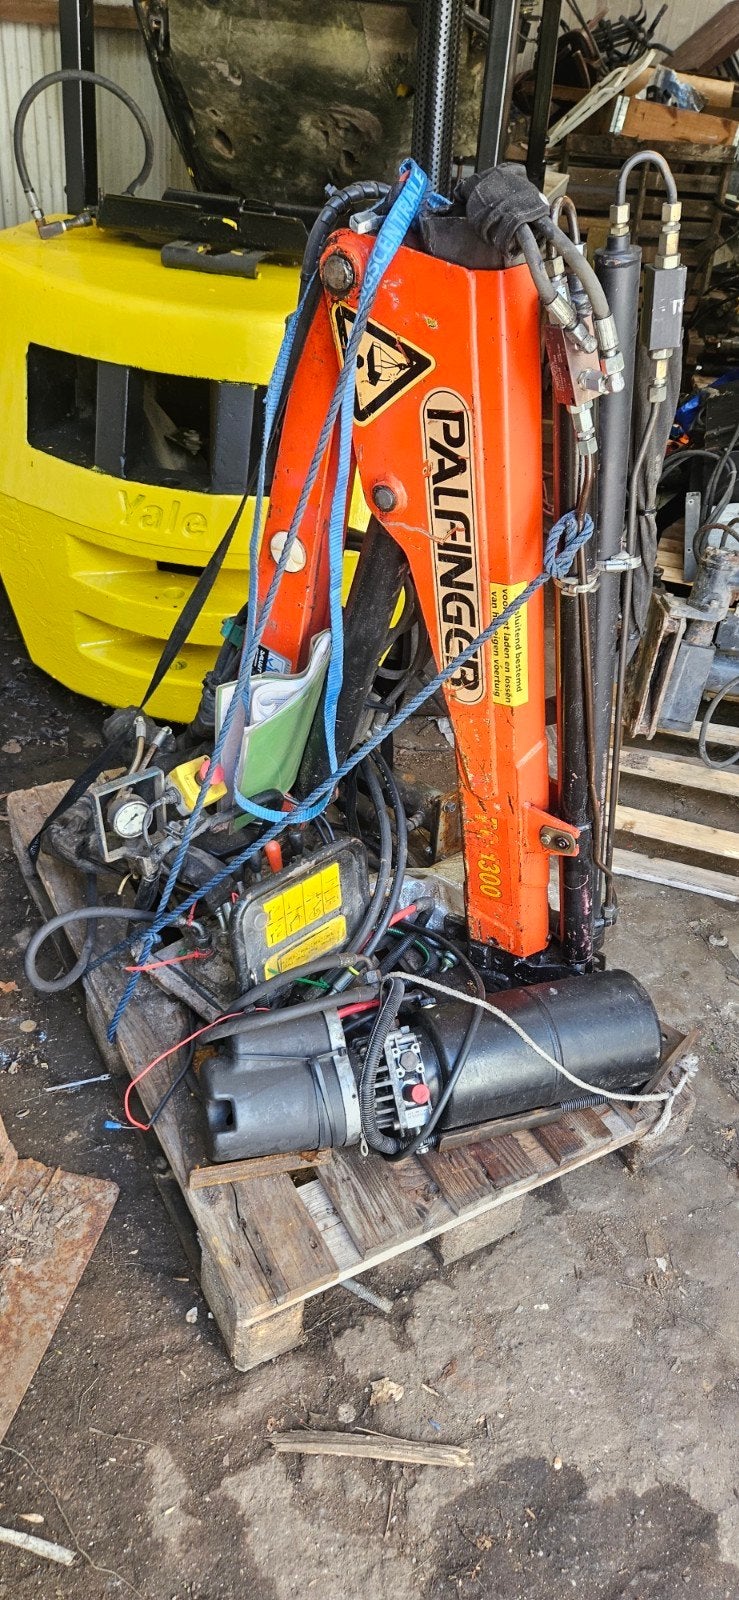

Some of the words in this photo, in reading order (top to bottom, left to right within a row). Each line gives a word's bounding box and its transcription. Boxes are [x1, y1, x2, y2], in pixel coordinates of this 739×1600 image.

[119, 490, 208, 537] Yale
[427, 409, 480, 690] PALFINGER
[504, 661, 511, 673] en
[515, 652, 523, 692] bestemd
[478, 853, 502, 898] 1300
